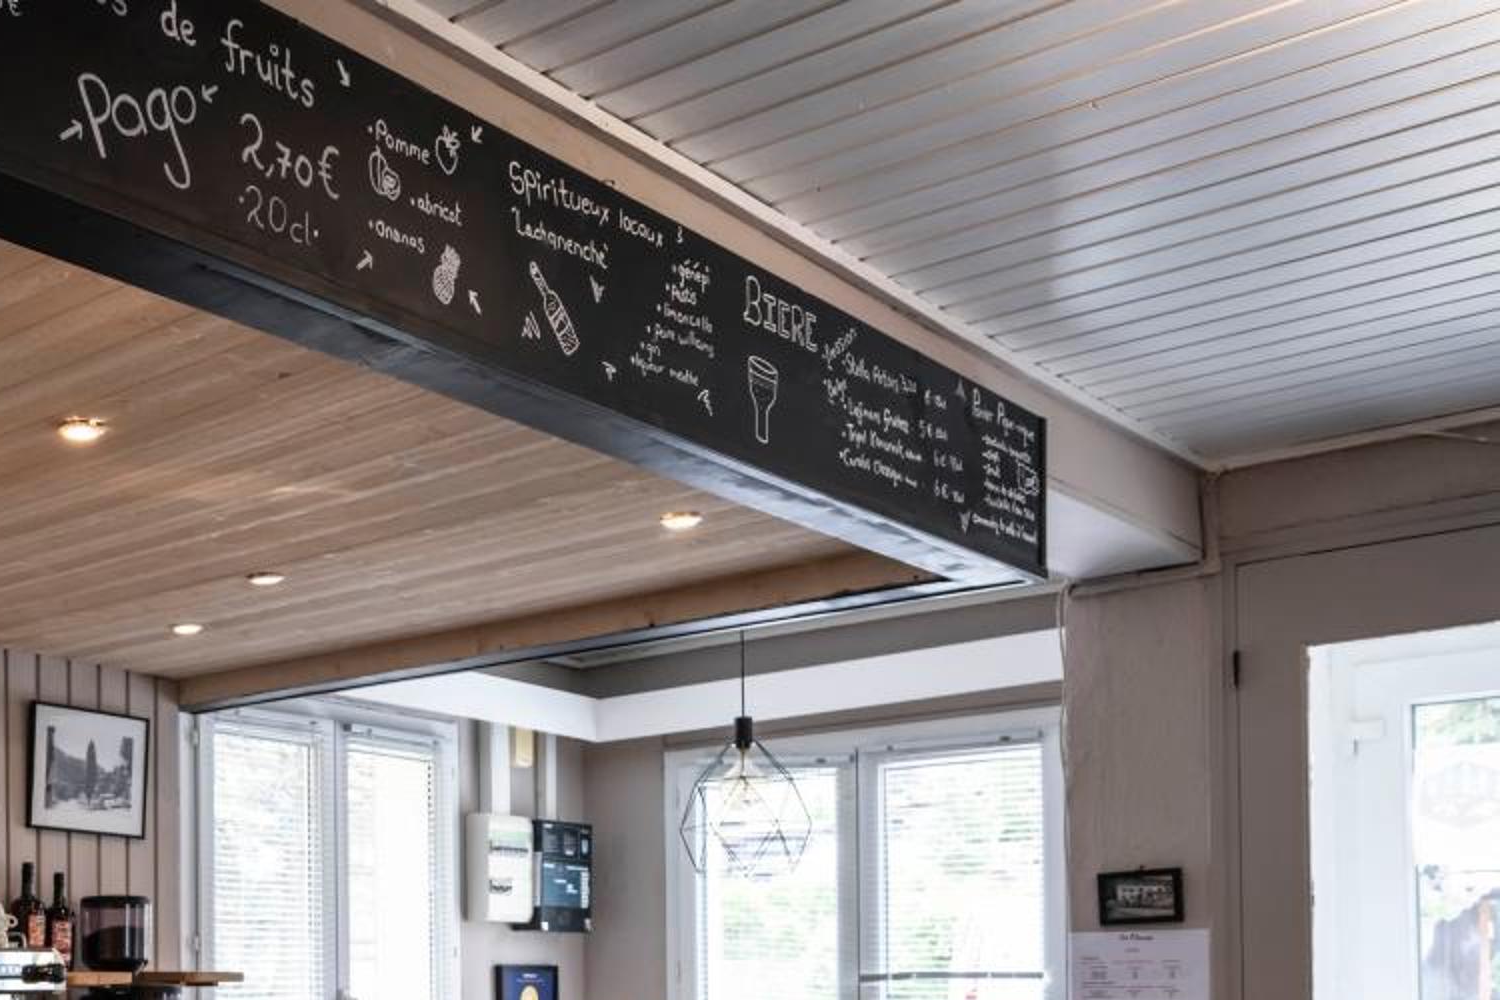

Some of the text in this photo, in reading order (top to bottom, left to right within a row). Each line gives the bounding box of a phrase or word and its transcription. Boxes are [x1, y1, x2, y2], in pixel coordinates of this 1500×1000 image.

[160, 0, 315, 108] de fruits
[77, 73, 197, 189] Pago
[240, 113, 340, 200] 2,70€
[374, 118, 430, 165] Pomme
[375, 220, 426, 254] ananas
[416, 192, 463, 227] abricot
[509, 161, 665, 248] Spiritueux locaux
[743, 275, 818, 353] BIERE
